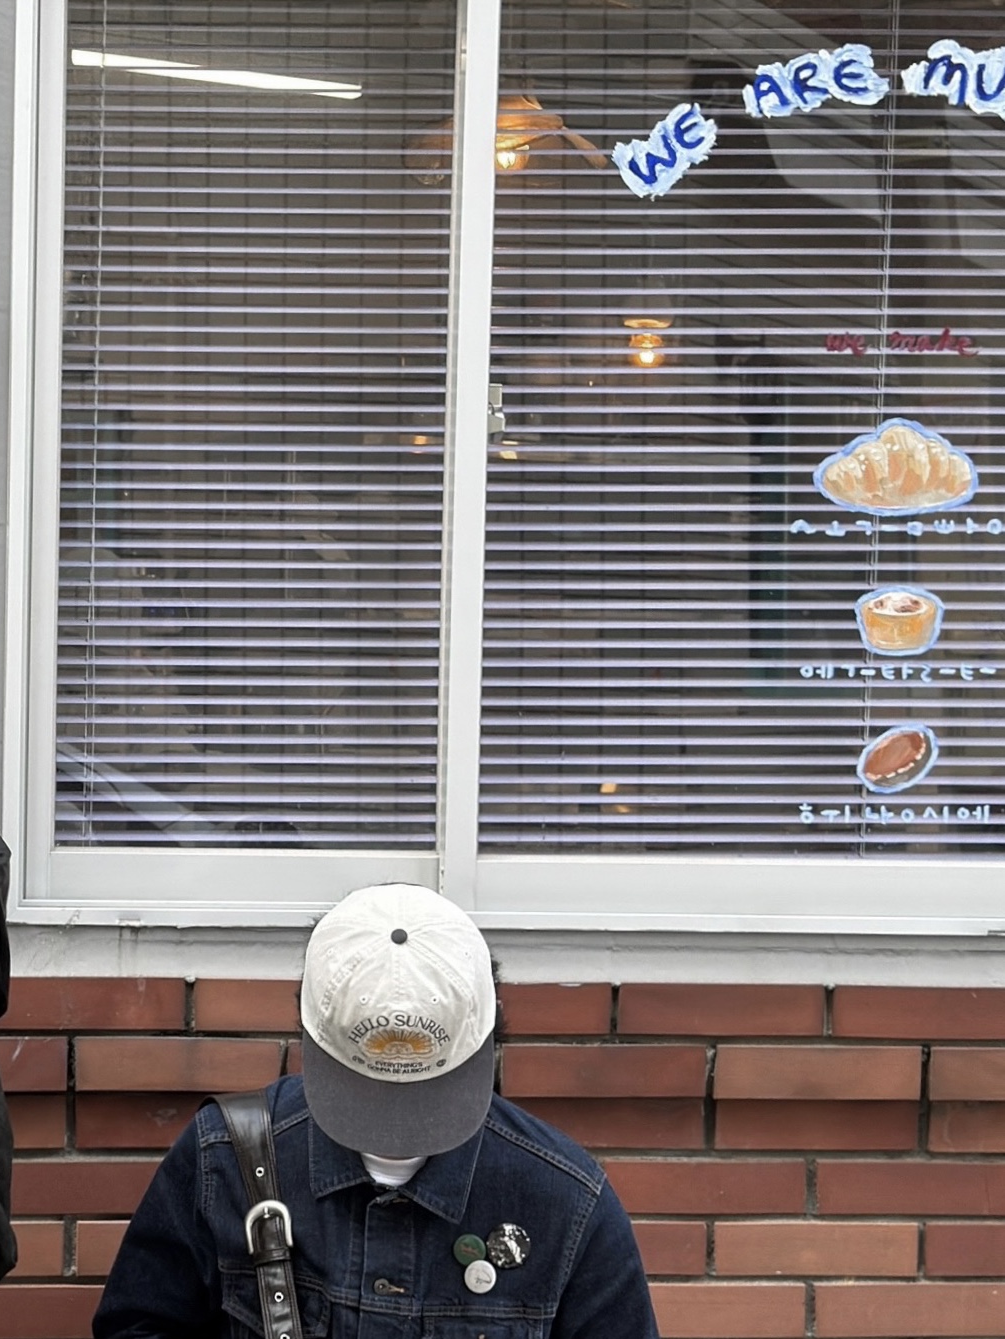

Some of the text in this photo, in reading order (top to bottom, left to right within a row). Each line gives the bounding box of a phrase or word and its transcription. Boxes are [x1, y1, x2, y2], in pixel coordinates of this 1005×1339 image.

[628, 104, 705, 186] WE
[753, 59, 868, 115] ARE
[825, 326, 980, 357] we make
[348, 1014, 451, 1047] HELLO SUNRISE
